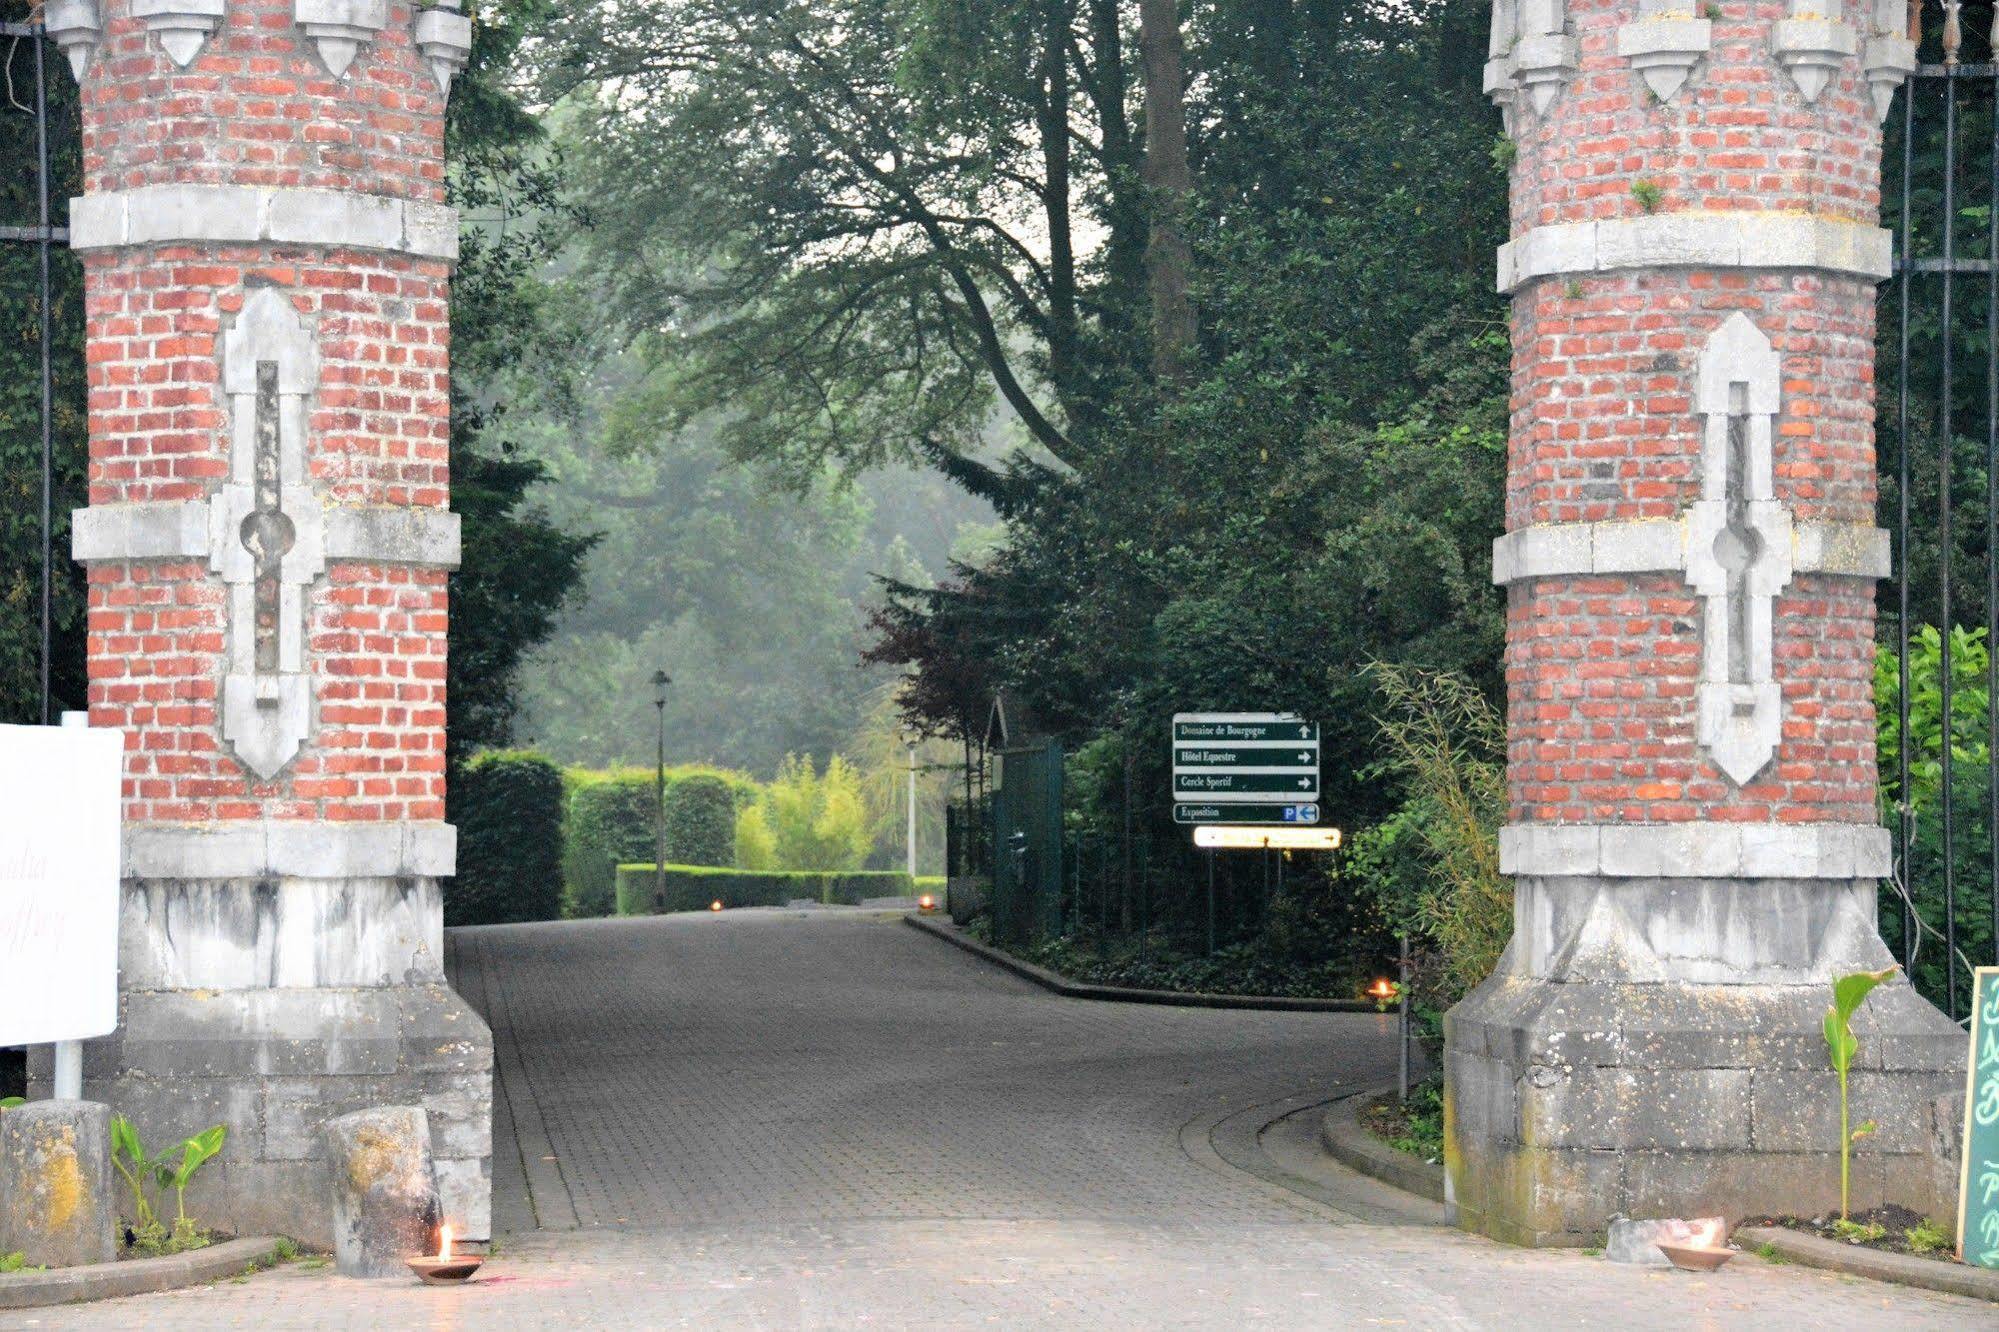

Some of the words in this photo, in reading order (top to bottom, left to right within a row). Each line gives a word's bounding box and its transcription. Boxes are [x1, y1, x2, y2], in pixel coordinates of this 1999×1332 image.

[1181, 725, 1214, 735] Domaine
[1216, 725, 1225, 735] de
[1227, 725, 1266, 738] Bourgogne
[1181, 751, 1202, 761] Hôtel
[1203, 751, 1236, 763] Equestre
[1181, 776, 1204, 786] Cercle
[1207, 776, 1232, 788] Sportif
[1181, 807, 1219, 819] Exposition
[1285, 809, 1294, 819] P
